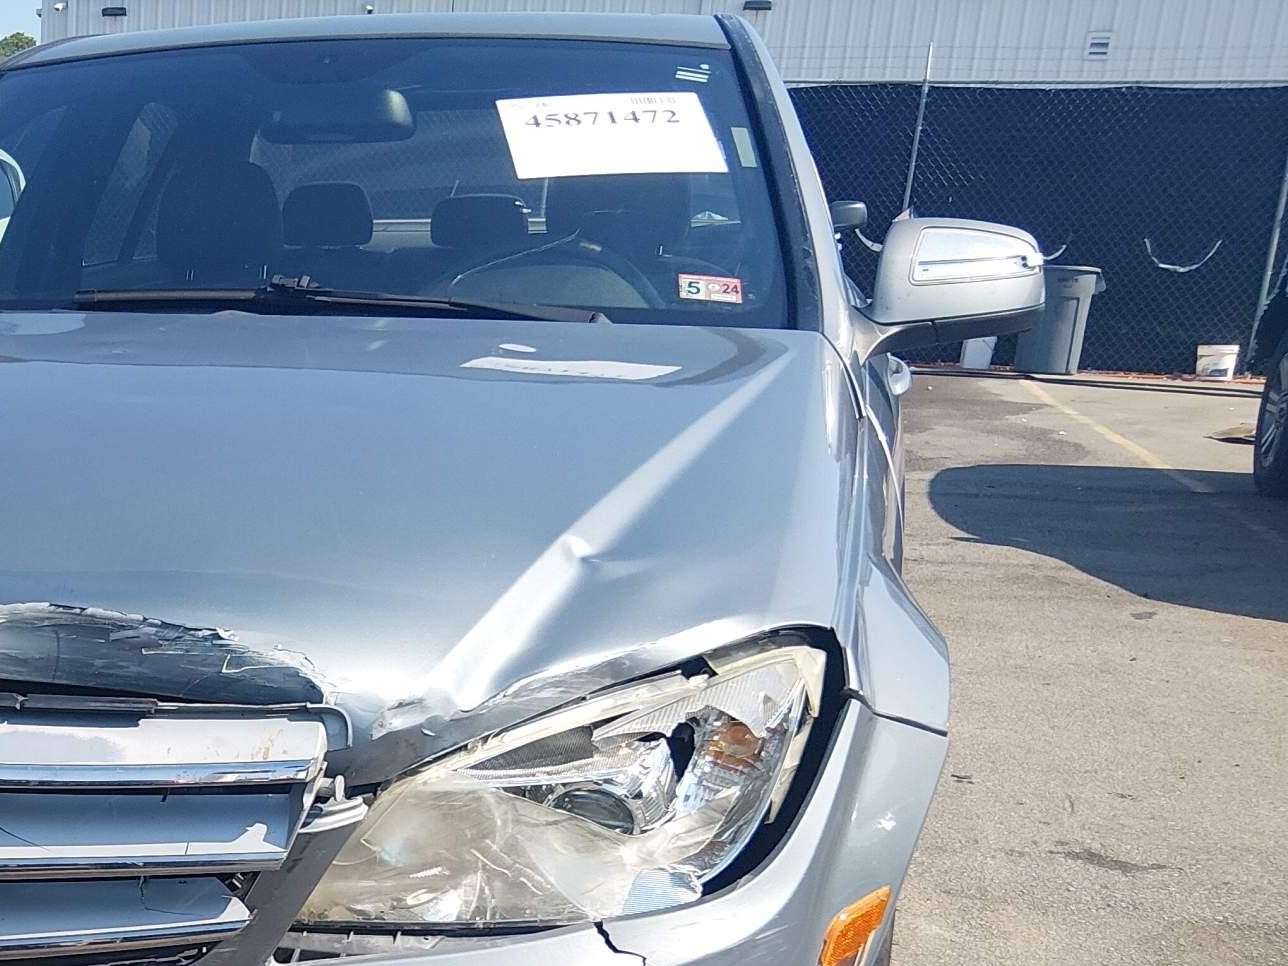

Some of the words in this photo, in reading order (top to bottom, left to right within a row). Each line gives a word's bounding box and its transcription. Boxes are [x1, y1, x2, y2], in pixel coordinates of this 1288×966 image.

[525, 109, 681, 128] 45871472
[686, 281, 701, 295] 5
[721, 283, 740, 295] 24
